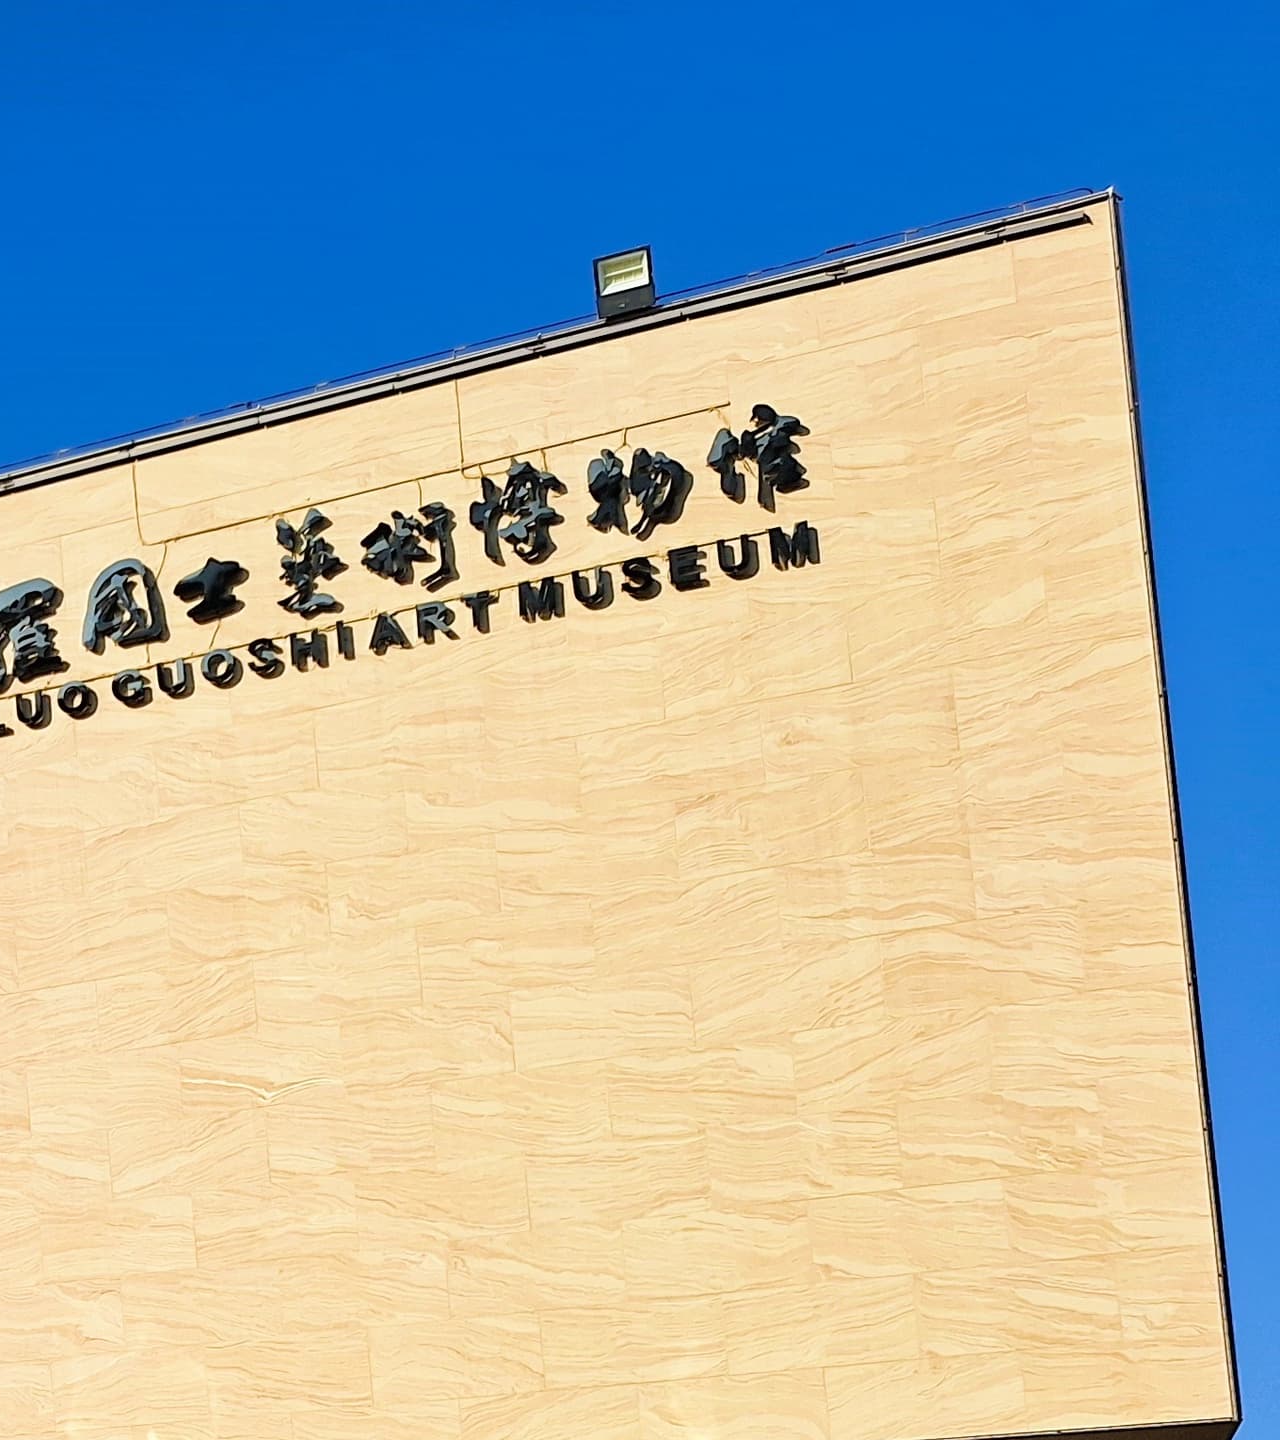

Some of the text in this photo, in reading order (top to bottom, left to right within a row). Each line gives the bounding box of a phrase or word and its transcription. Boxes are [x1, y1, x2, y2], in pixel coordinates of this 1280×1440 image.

[111, 620, 356, 709] GUOSHI
[368, 590, 500, 656] ART
[517, 520, 821, 623] MUSEUM
